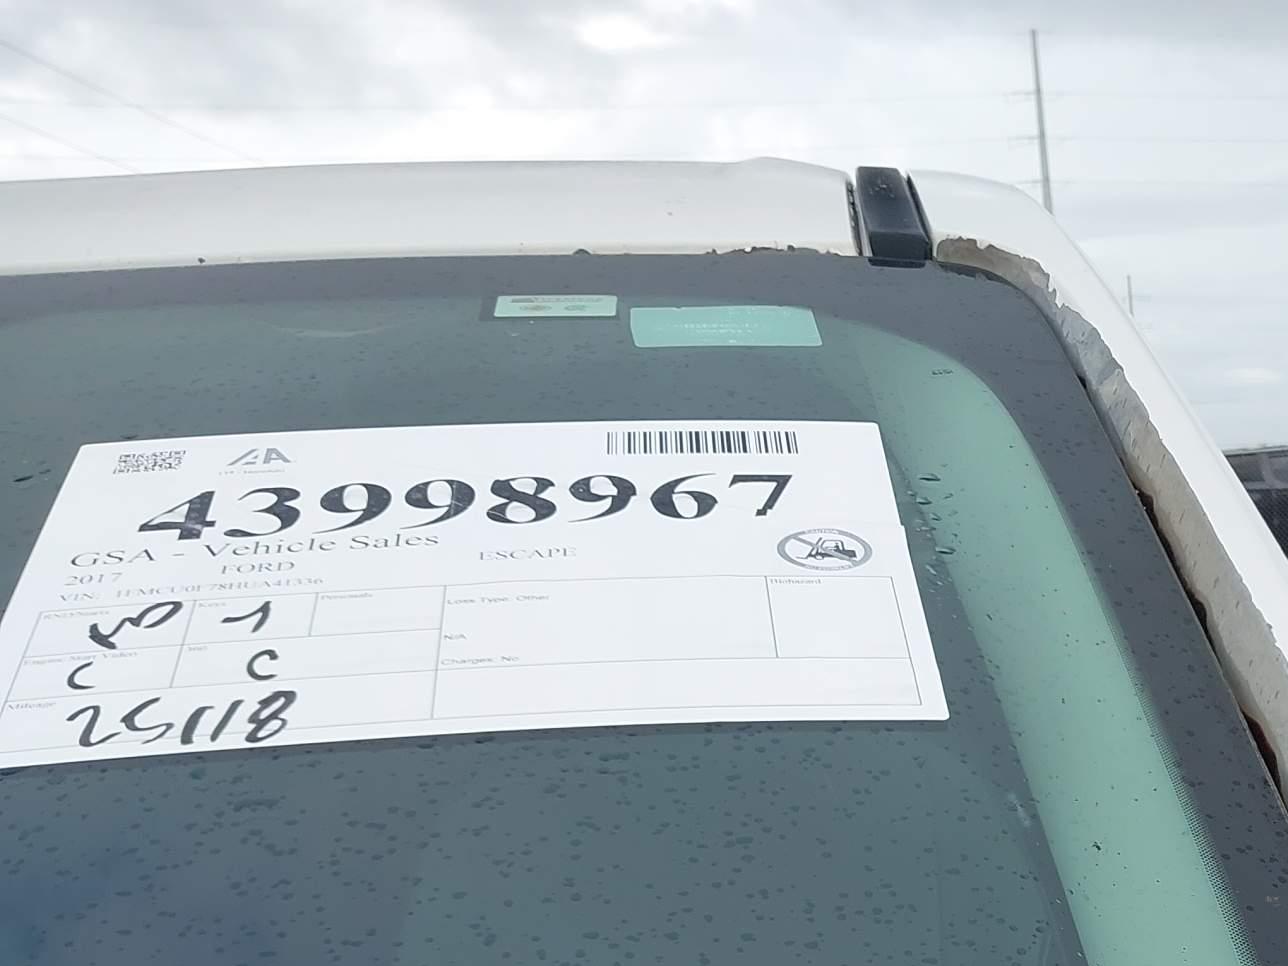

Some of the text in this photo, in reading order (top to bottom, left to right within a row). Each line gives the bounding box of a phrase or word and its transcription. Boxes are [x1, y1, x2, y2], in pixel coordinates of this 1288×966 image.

[137, 472, 794, 541] 43998967
[70, 548, 156, 568] GSA
[203, 529, 338, 558] Vehicle
[348, 525, 441, 550] Sales
[221, 547, 577, 575] FORD ESCAPE
[63, 571, 123, 587] 2017
[66, 660, 97, 690] C
[246, 648, 280, 681] C
